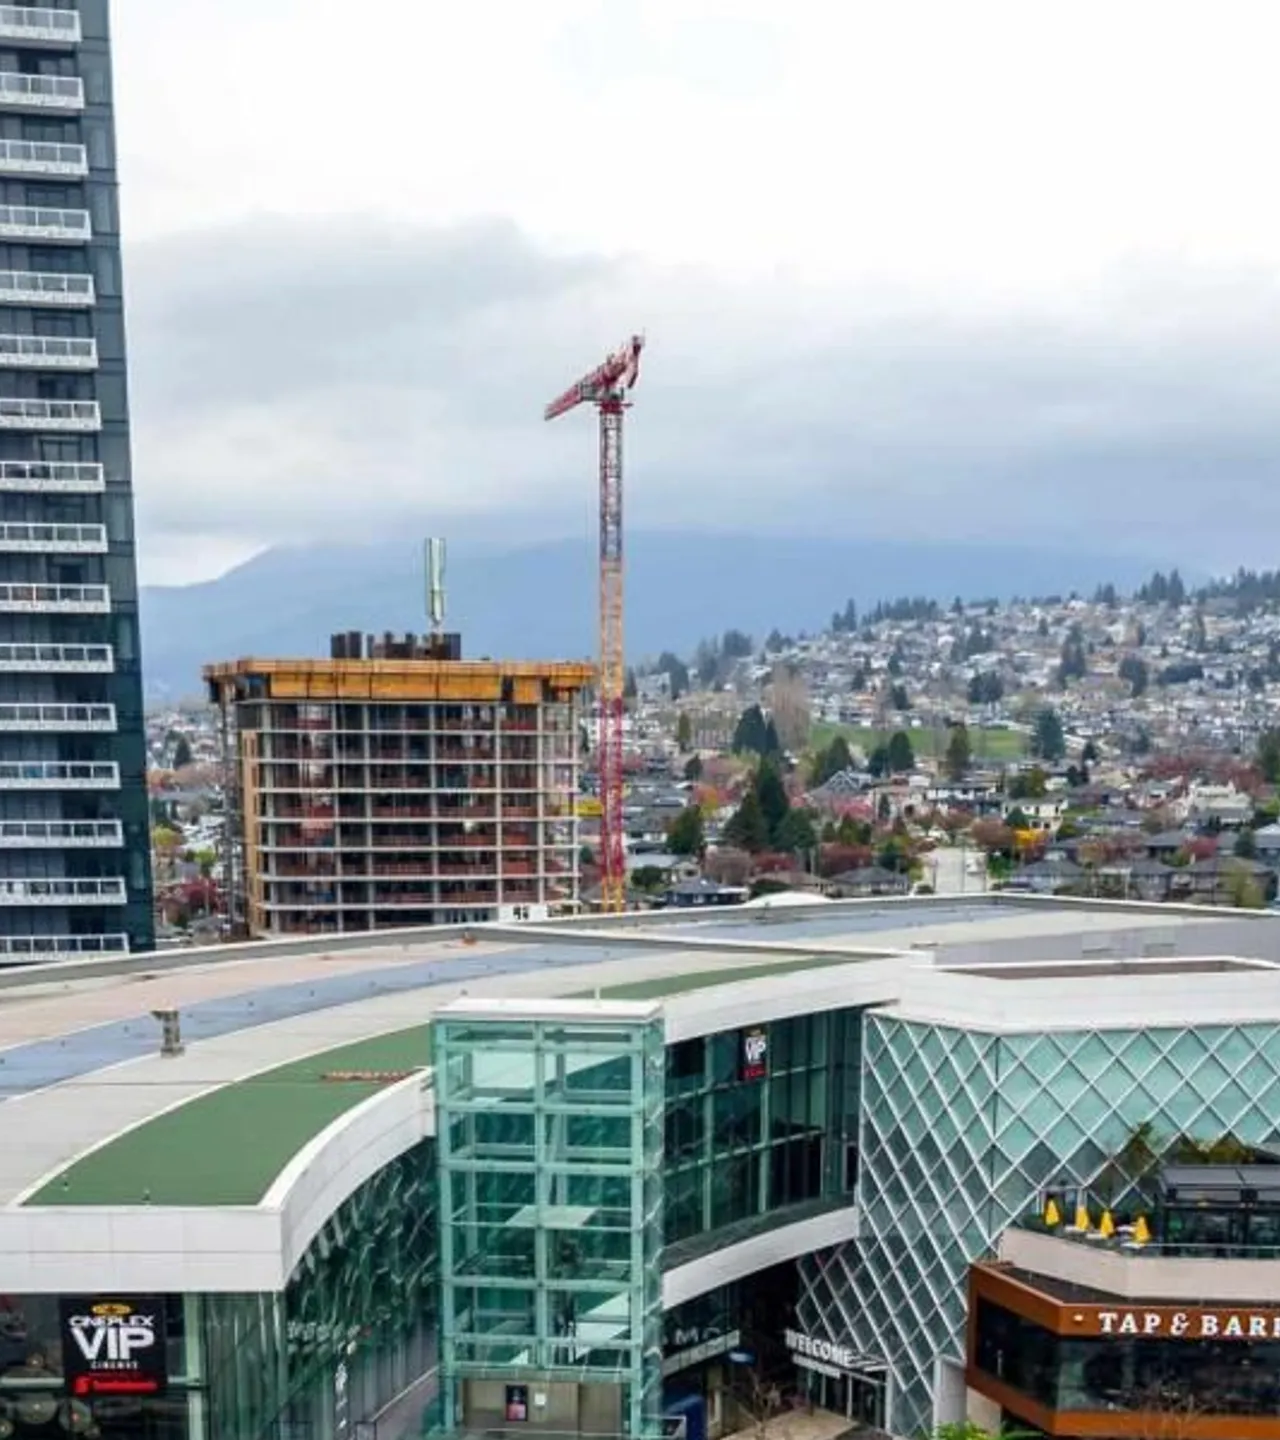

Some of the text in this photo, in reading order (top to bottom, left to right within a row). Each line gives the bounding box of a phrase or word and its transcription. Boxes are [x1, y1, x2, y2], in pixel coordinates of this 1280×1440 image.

[1098, 1312, 1162, 1335] TAP
[1169, 1312, 1191, 1336] &
[71, 1327, 155, 1360] VIP
